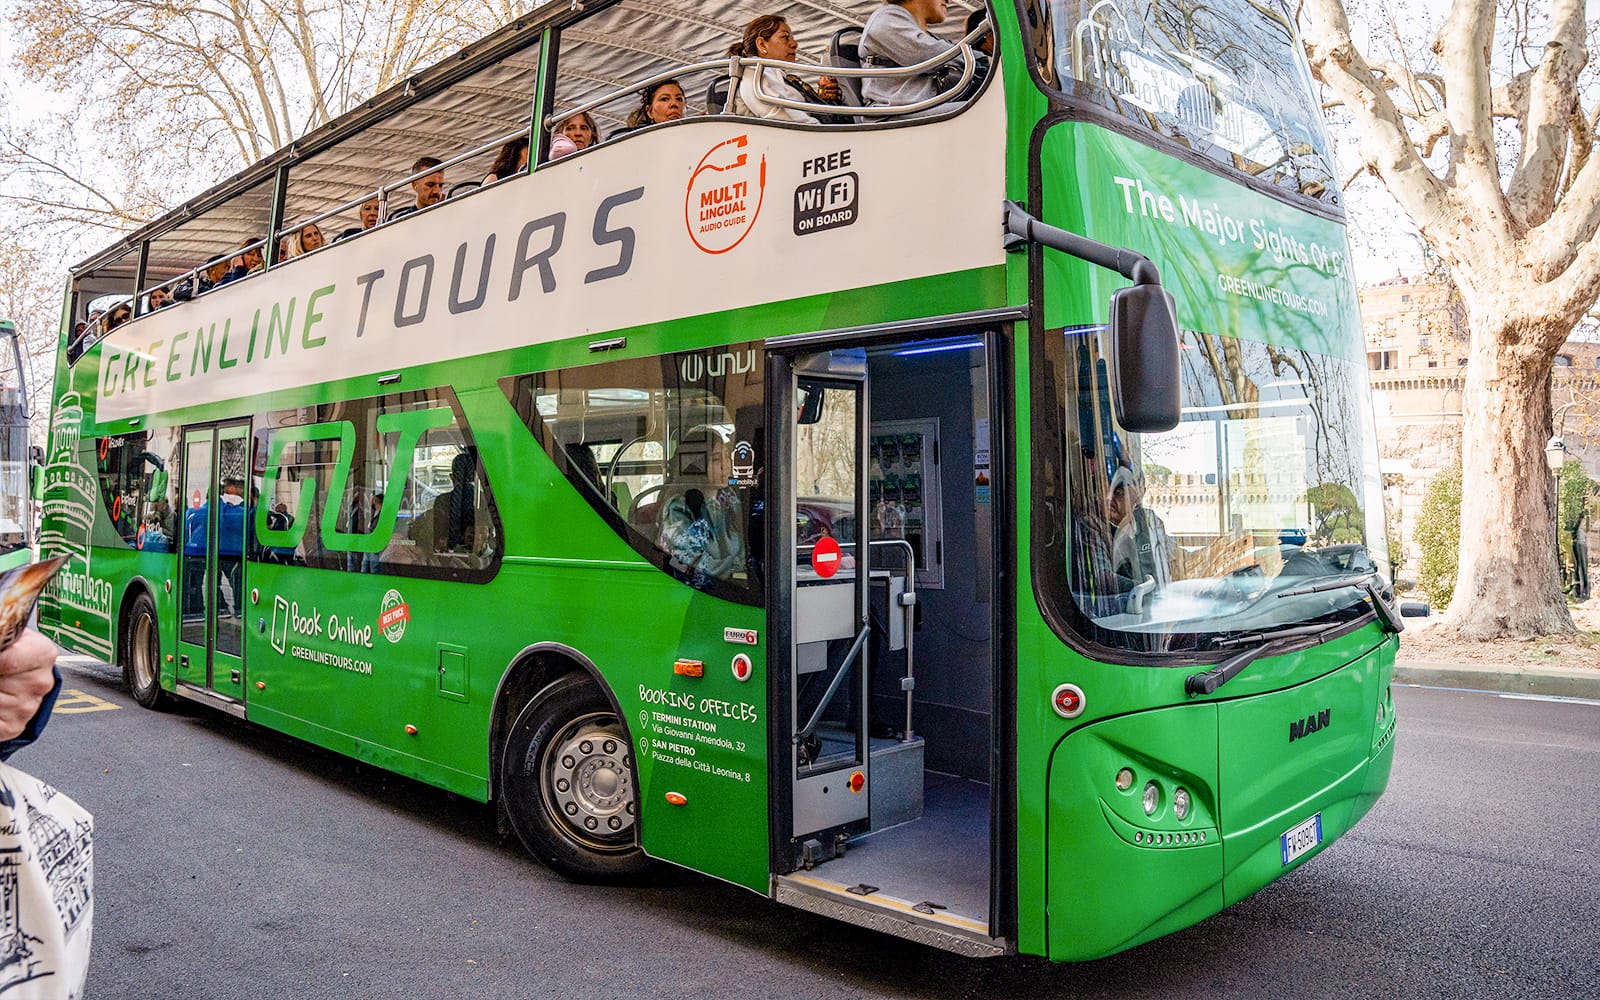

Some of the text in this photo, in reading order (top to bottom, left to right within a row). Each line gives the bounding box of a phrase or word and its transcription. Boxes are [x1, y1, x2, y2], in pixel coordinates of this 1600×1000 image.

[802, 149, 851, 178] FREE
[700, 181, 747, 208] MULTI
[798, 182, 848, 212] WiFi
[700, 200, 746, 222] LINGUAL
[700, 215, 746, 234] AUDIO GUIDE
[799, 210, 852, 231] ON BOARD
[1113, 175, 1176, 223] The
[1178, 194, 1245, 246] Major
[1250, 218, 1309, 266] Sights
[1310, 242, 1330, 274] Of
[103, 186, 645, 398] GREENLINE TOURS
[1217, 273, 1329, 318] GREENLINETOURS.COM
[292, 601, 373, 648] Book Online
[383, 613, 392, 625] BEST
[291, 645, 372, 675] GREENLINETOURS.COM
[639, 683, 758, 724] BOOKING OFFICES
[652, 711, 717, 733] TERMINI STATION
[1289, 707, 1331, 744] MAN
[652, 724, 746, 753] Via Giovanni Amendola, 32
[652, 739, 695, 756] SAN PIETRO
[652, 750, 751, 783] Piazza della Città Leonina, 8
